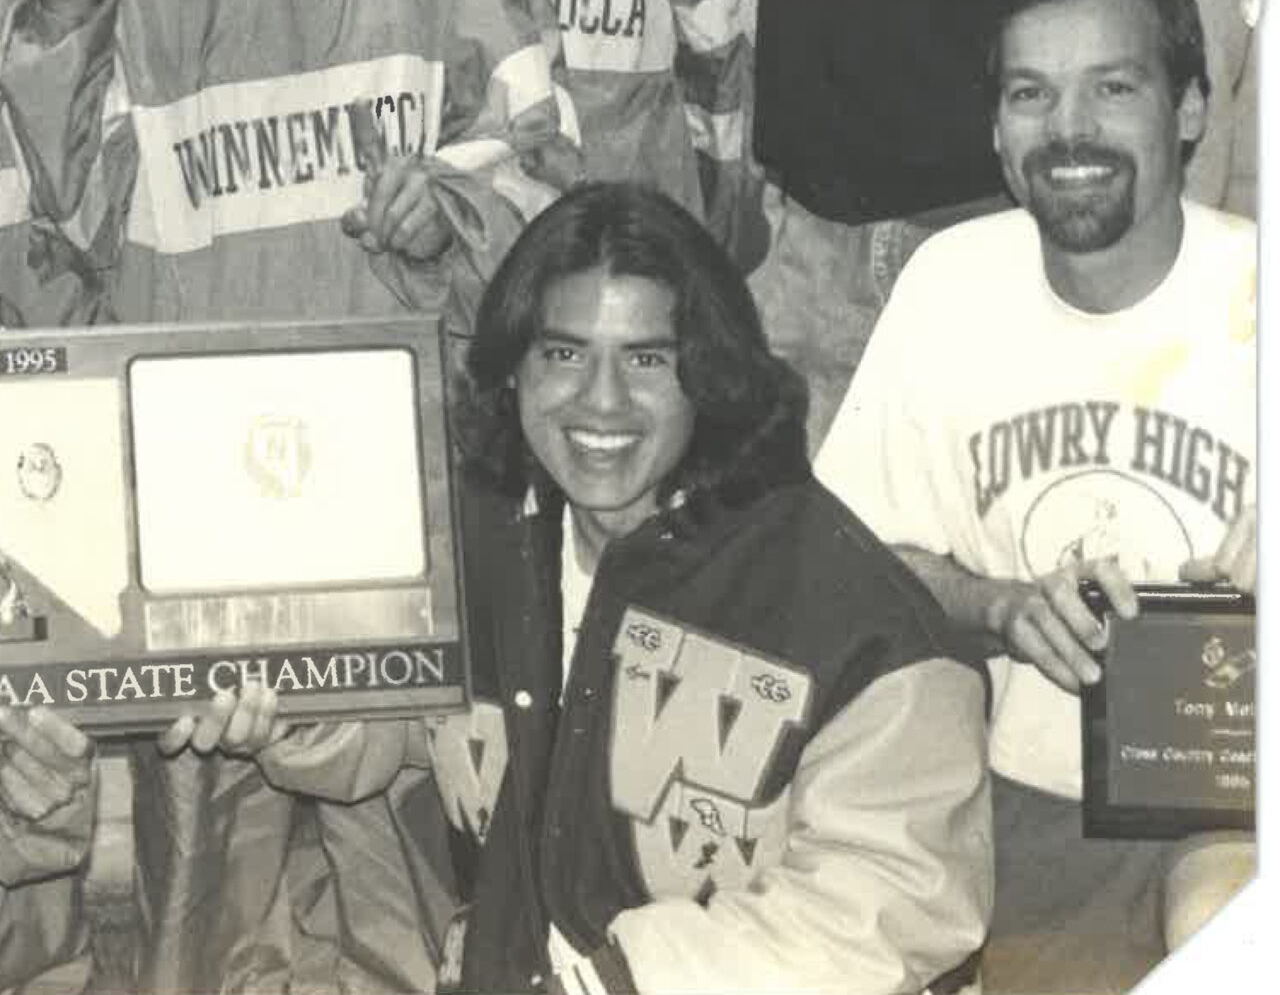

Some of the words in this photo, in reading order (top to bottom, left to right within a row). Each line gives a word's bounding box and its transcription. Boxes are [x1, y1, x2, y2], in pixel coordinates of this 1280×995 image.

[5, 348, 57, 375] 1995
[969, 401, 1120, 520] LOWRY
[1130, 406, 1251, 524] HIGH
[65, 663, 197, 703] STATE
[206, 648, 445, 696] CHAMPION
